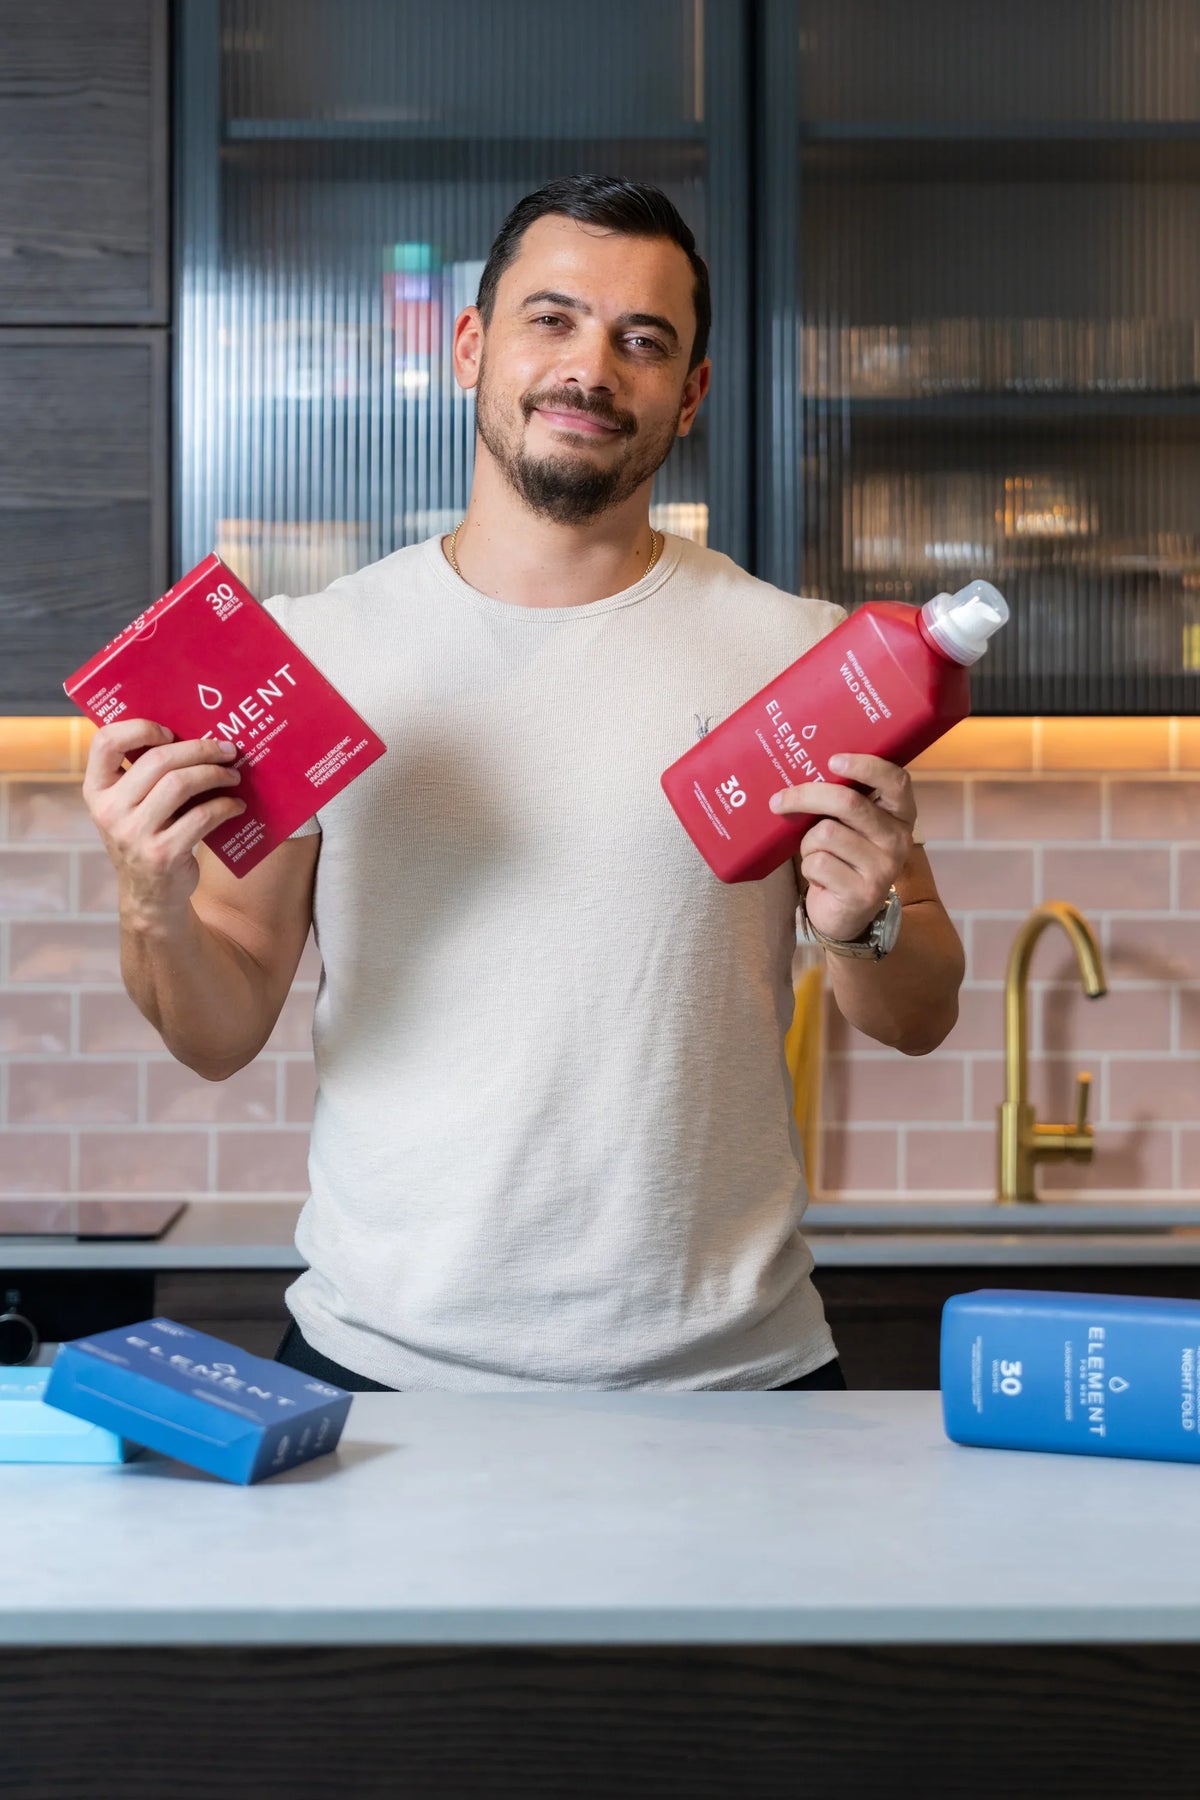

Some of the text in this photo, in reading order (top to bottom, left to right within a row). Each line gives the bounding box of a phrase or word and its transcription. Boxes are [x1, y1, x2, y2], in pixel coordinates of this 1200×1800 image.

[205, 583, 234, 611] 30
[215, 595, 240, 617] SHEETS
[91, 683, 123, 711] FRAGRANCES
[840, 662, 881, 724] WILD SPICE
[846, 649, 892, 719] REFINED FRAGRANCES
[96, 697, 118, 718] WILD
[103, 702, 128, 725] SPICE
[248, 714, 275, 739] MEN
[256, 719, 289, 750] DETERGENT
[755, 728, 774, 758] LAUNDRY
[765, 699, 826, 783] ELEMENT
[248, 747, 271, 768] SHEETS
[304, 735, 352, 778] HYPOALLERGENIC
[313, 738, 369, 788] POWERED BY PLANTS
[714, 786, 733, 815] WASHES
[720, 774, 747, 808] 30
[221, 818, 257, 852] ZERO PLASTIC
[226, 822, 266, 857] ZERO LANDFILL
[232, 833, 265, 863] ZERO WASTE
[125, 1335, 297, 1407] ELEMENT
[1000, 1359, 1023, 1397] 30
[1088, 1326, 1106, 1437] ELEMENT
[1181, 1347, 1195, 1432] NIGHT FOLD
